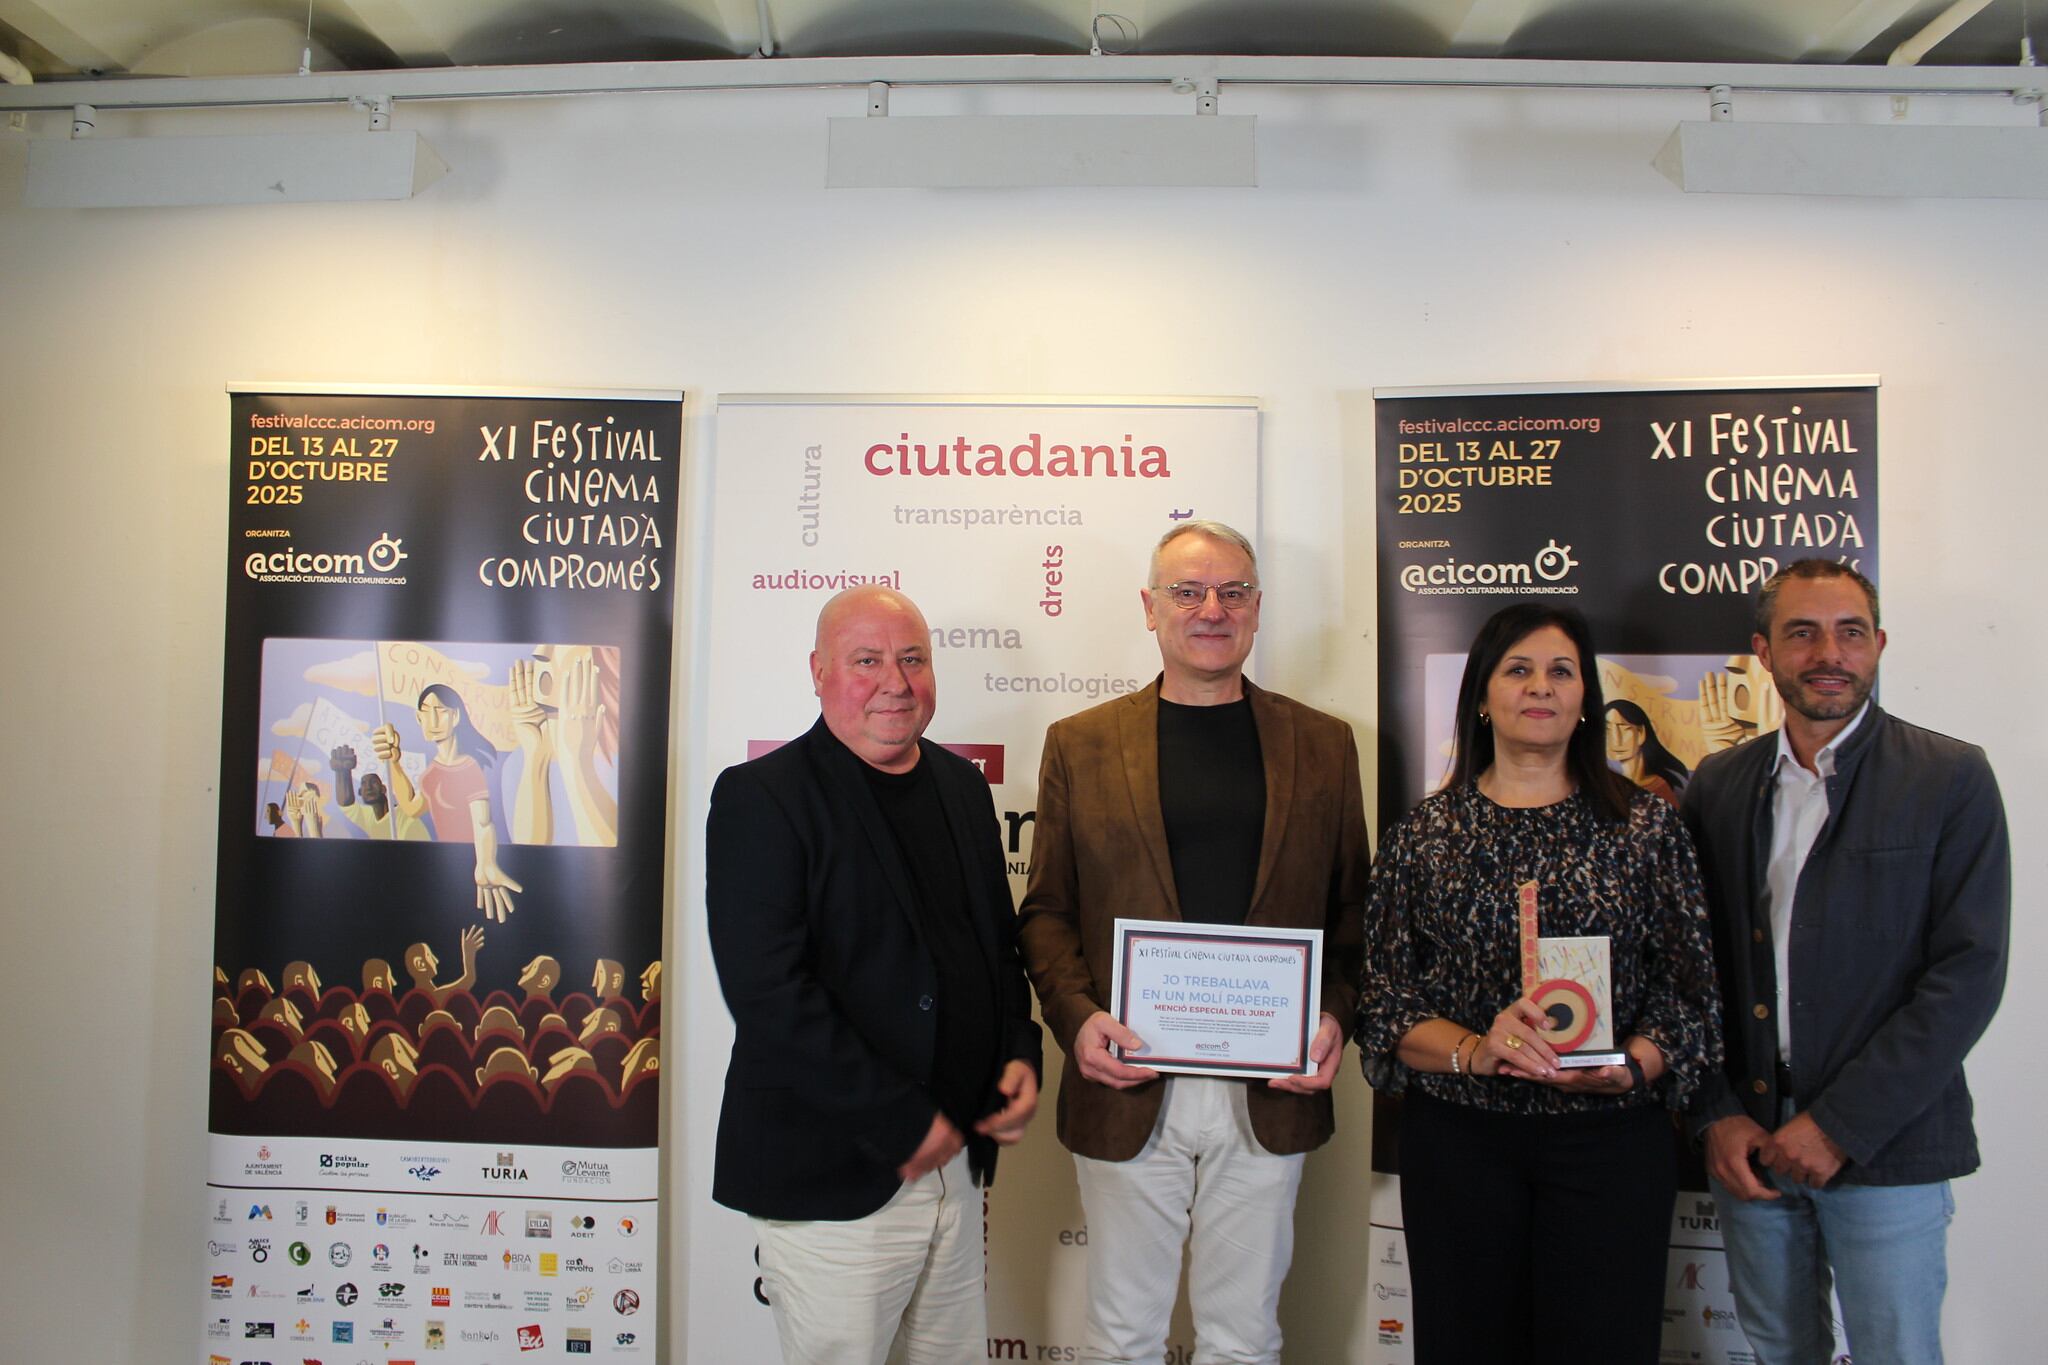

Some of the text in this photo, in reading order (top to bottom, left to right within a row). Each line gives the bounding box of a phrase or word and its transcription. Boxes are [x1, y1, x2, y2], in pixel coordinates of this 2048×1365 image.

[250, 414, 436, 434] festivalccc.acicom.org
[1398, 416, 1601, 434] festivalccc.acicom.org
[250, 437, 398, 458] DEL 13 AL 27
[478, 425, 516, 462] XI
[1650, 420, 1692, 460] XI
[864, 433, 1171, 478] ciutadania
[1399, 440, 1561, 463] DEL 13 AL 27
[249, 461, 388, 482] D'OCTUBRE
[1399, 465, 1552, 489] D'OCTUBRE
[247, 485, 303, 504] 2025
[797, 444, 823, 547] cultura
[1398, 493, 1462, 514] 2025
[893, 504, 1083, 531] transparència
[245, 530, 291, 538] ORGANITZA
[1399, 540, 1451, 549] ORGANITZA
[259, 574, 302, 582] ASSOCIACIÓ
[303, 576, 347, 584] CIUTADANIA
[353, 576, 407, 584] COMUNICACIÓ
[752, 570, 900, 591] audiovisual
[1039, 545, 1064, 618] drets
[1418, 586, 1464, 595] ASSOCIACIÓ
[1520, 585, 1579, 594] COMUNICACIÓ
[928, 625, 1023, 649] nema
[984, 673, 1139, 699] tecnologies
[1138, 948, 1149, 958] XI
[1162, 974, 1270, 990] JO TREBALLAVA
[1142, 989, 1289, 1008] EN UN MOLÍ PAPERER
[1154, 1004, 1276, 1018] MENCIÓ ESPECIAL DEL JURAT
[482, 1167, 528, 1180] TURIA
[576, 1168, 611, 1177] Levante
[578, 1160, 609, 1170] Mutua
[1679, 1216, 1720, 1231] TURI
[566, 1264, 594, 1273] revolta
